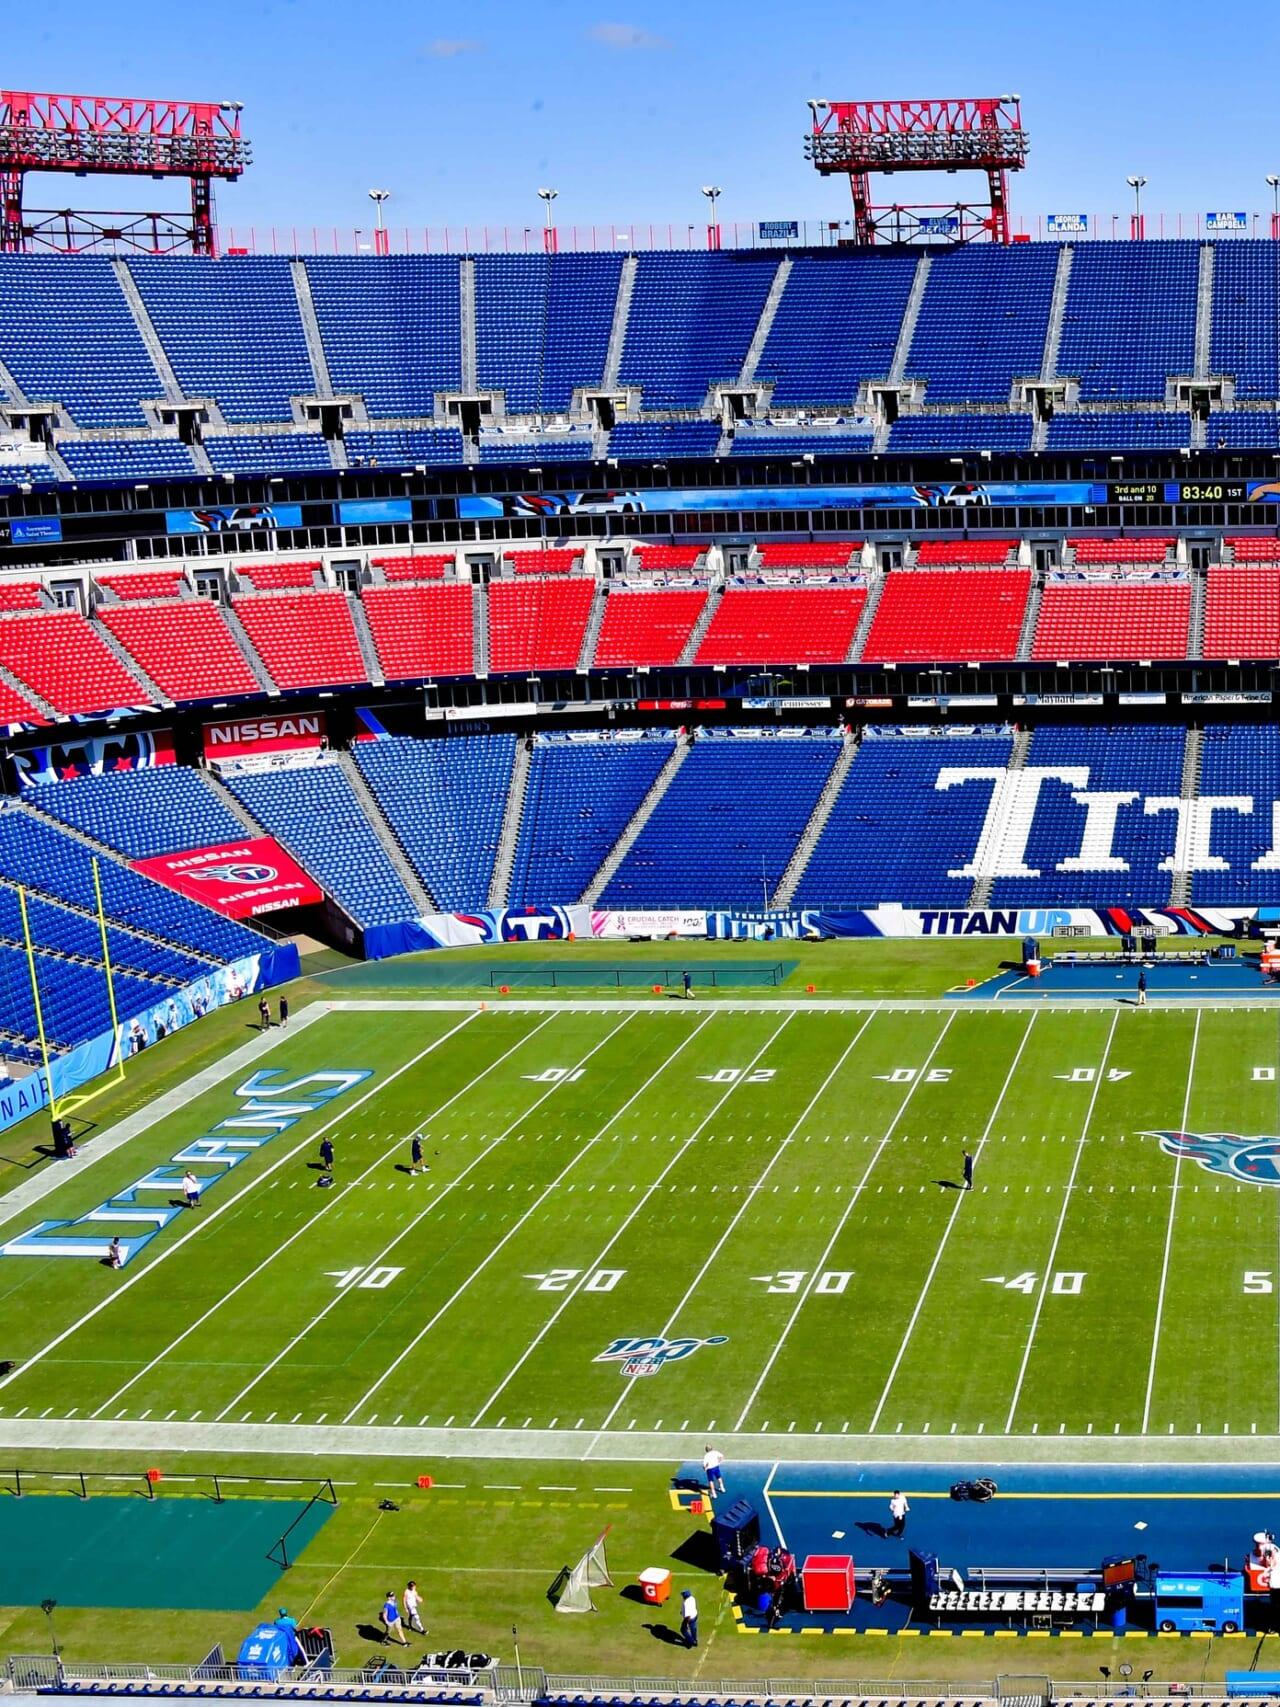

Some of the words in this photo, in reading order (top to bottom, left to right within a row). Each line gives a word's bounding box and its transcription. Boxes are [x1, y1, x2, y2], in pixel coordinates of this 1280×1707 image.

[1216, 212, 1235, 221] EARL
[764, 222, 792, 230] ROBERT
[1049, 221, 1086, 231] BLANDA
[1207, 221, 1246, 229] CAMPBELL
[762, 230, 798, 238] BRAZILE
[1114, 486, 1127, 494] 3rd
[1128, 486, 1145, 494] and
[1182, 486, 1222, 499] 83:40
[1227, 489, 1242, 497] 1ST
[211, 717, 319, 744] NISSAN
[166, 848, 252, 870] NISSAN
[217, 882, 305, 904] NISSAN
[252, 897, 300, 915] NISSAN
[0, 1068, 375, 1270] TITANS
[334, 1266, 406, 1289] 10
[537, 1269, 628, 1291] 20
[768, 1271, 856, 1294] 30
[1004, 1272, 1088, 1294] 40
[625, 1364, 656, 1373] NFL
[420, 1478, 430, 1488] 20
[645, 1585, 656, 1597] G
